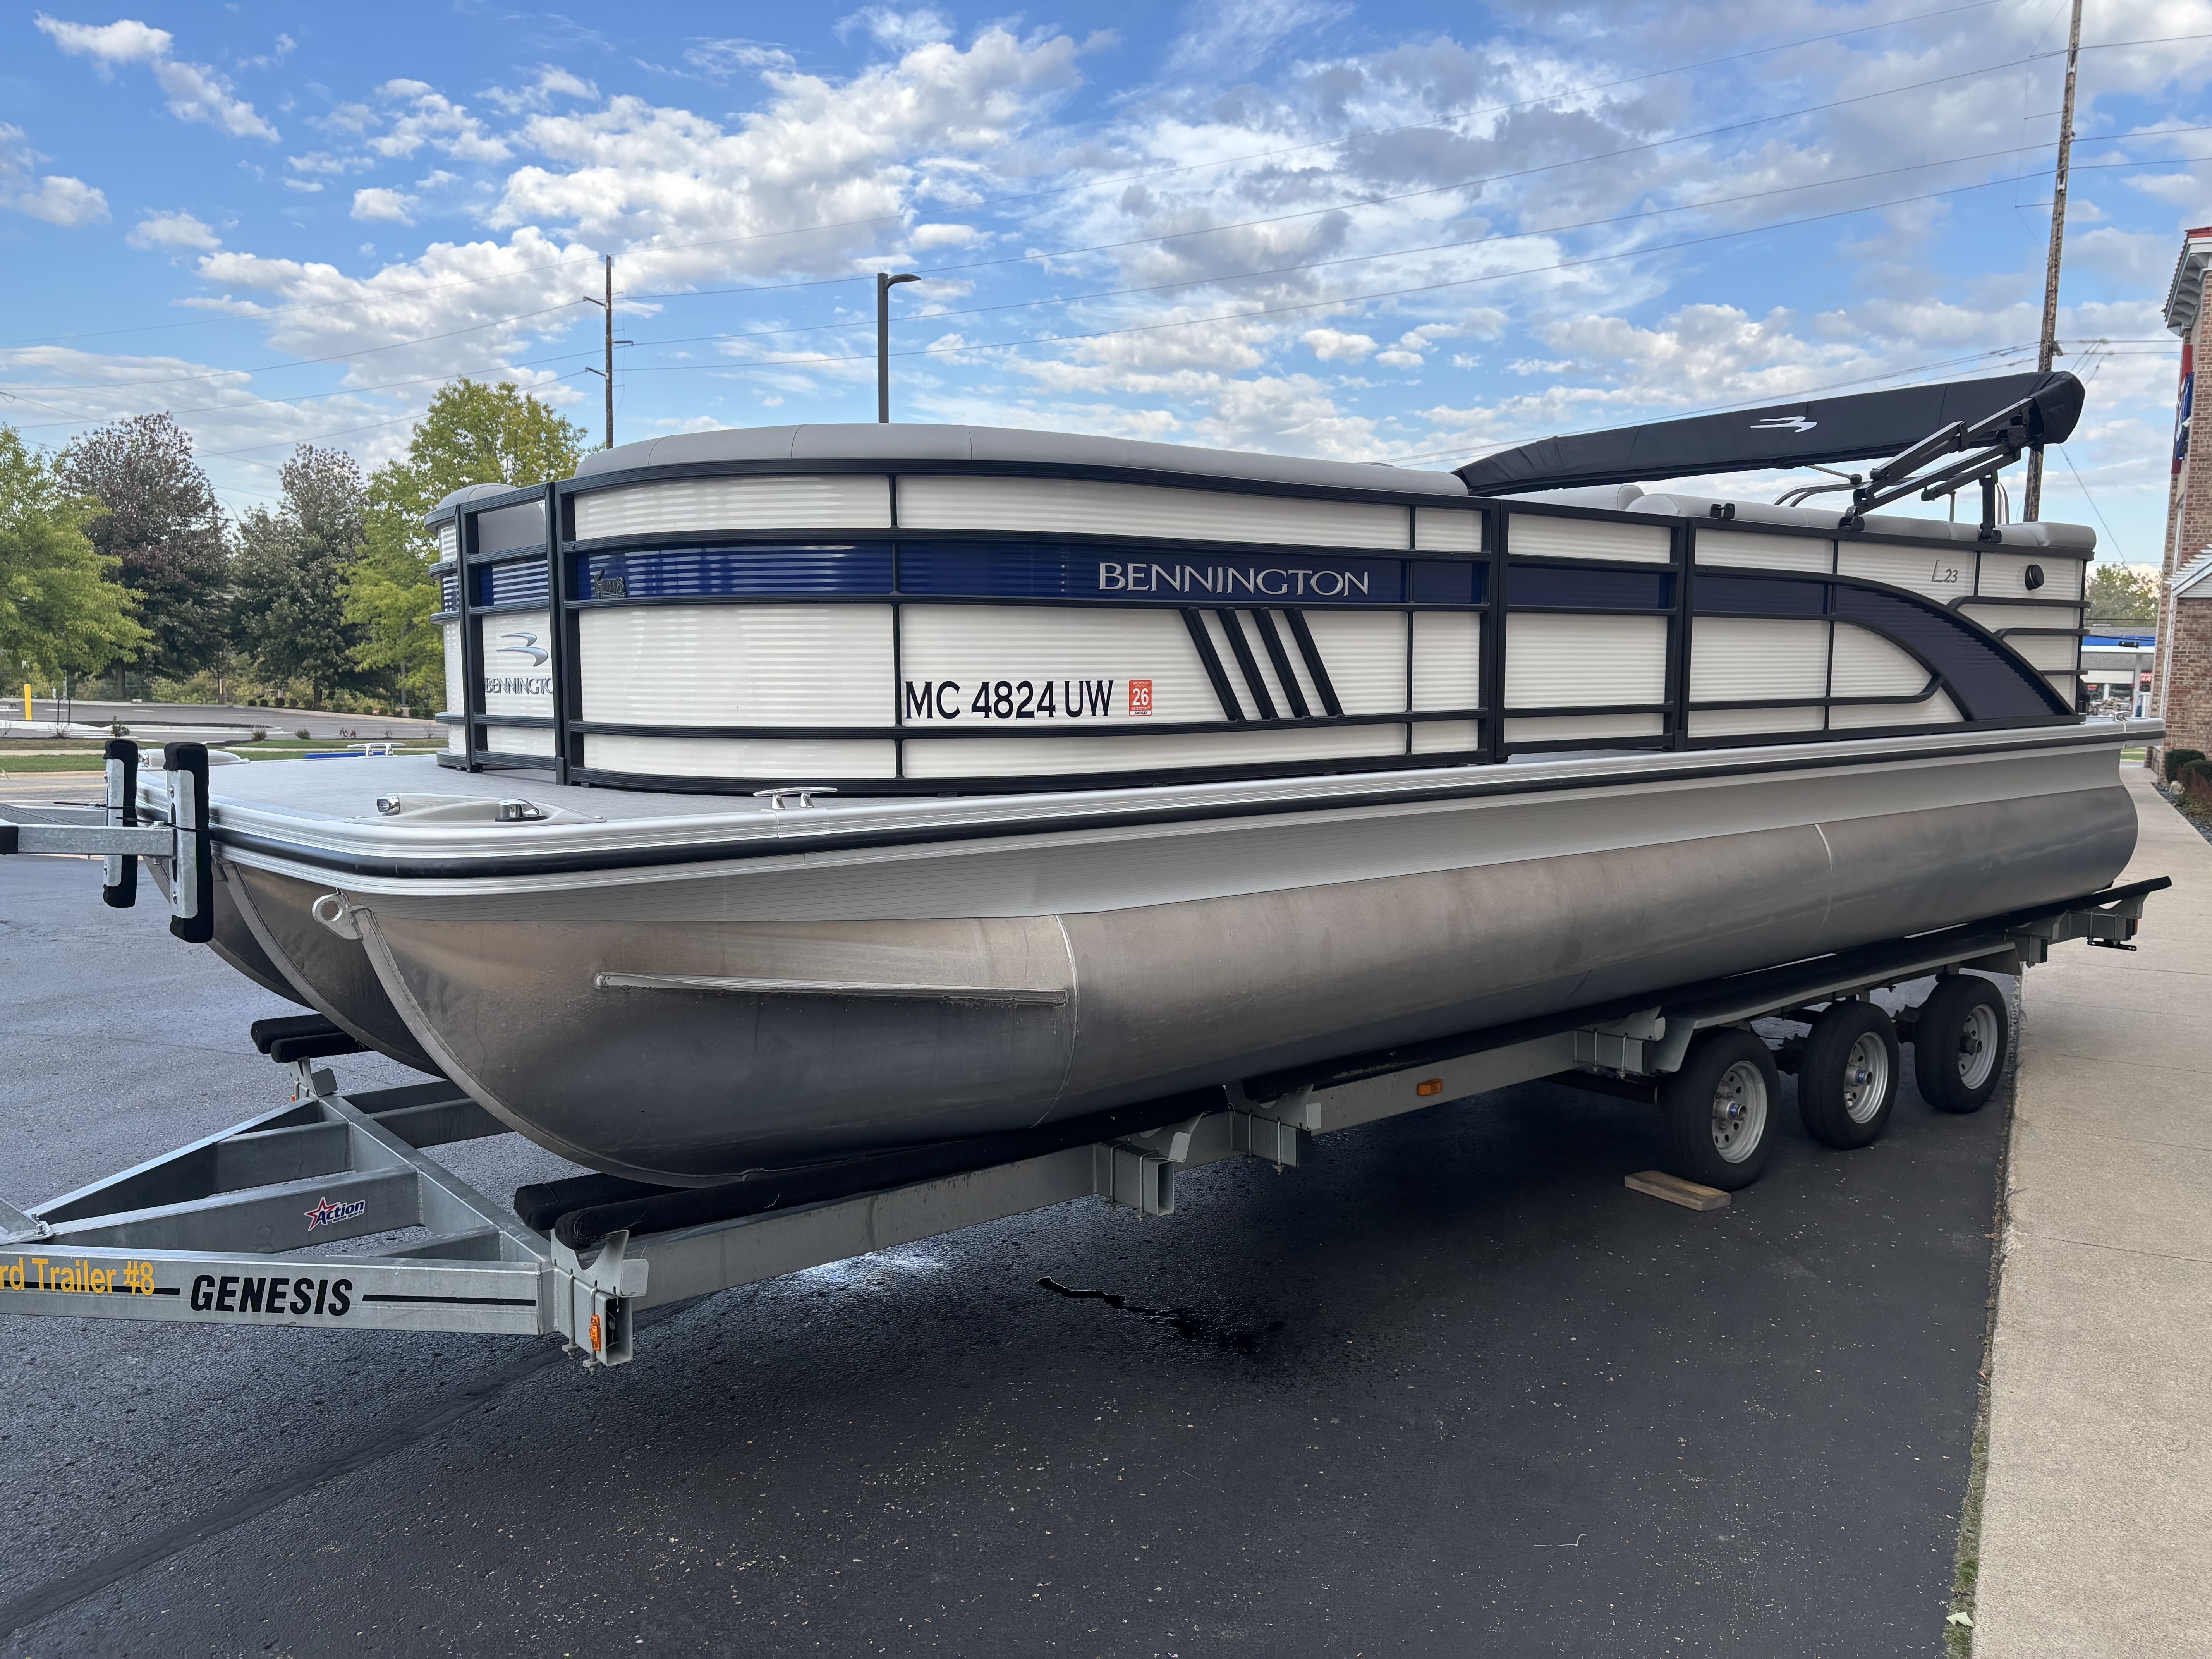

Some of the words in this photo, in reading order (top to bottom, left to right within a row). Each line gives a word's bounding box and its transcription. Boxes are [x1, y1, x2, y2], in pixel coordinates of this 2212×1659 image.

[1099, 562, 1368, 596] BENNINGTON
[905, 681, 961, 719] MC
[971, 681, 1056, 719] 4824
[1064, 680, 1114, 718] UW
[1132, 687, 1149, 706] 26
[315, 1201, 364, 1224] Action
[32, 1258, 117, 1294] Trailer
[123, 1261, 155, 1296] #8
[191, 1274, 353, 1316] GENESIS
